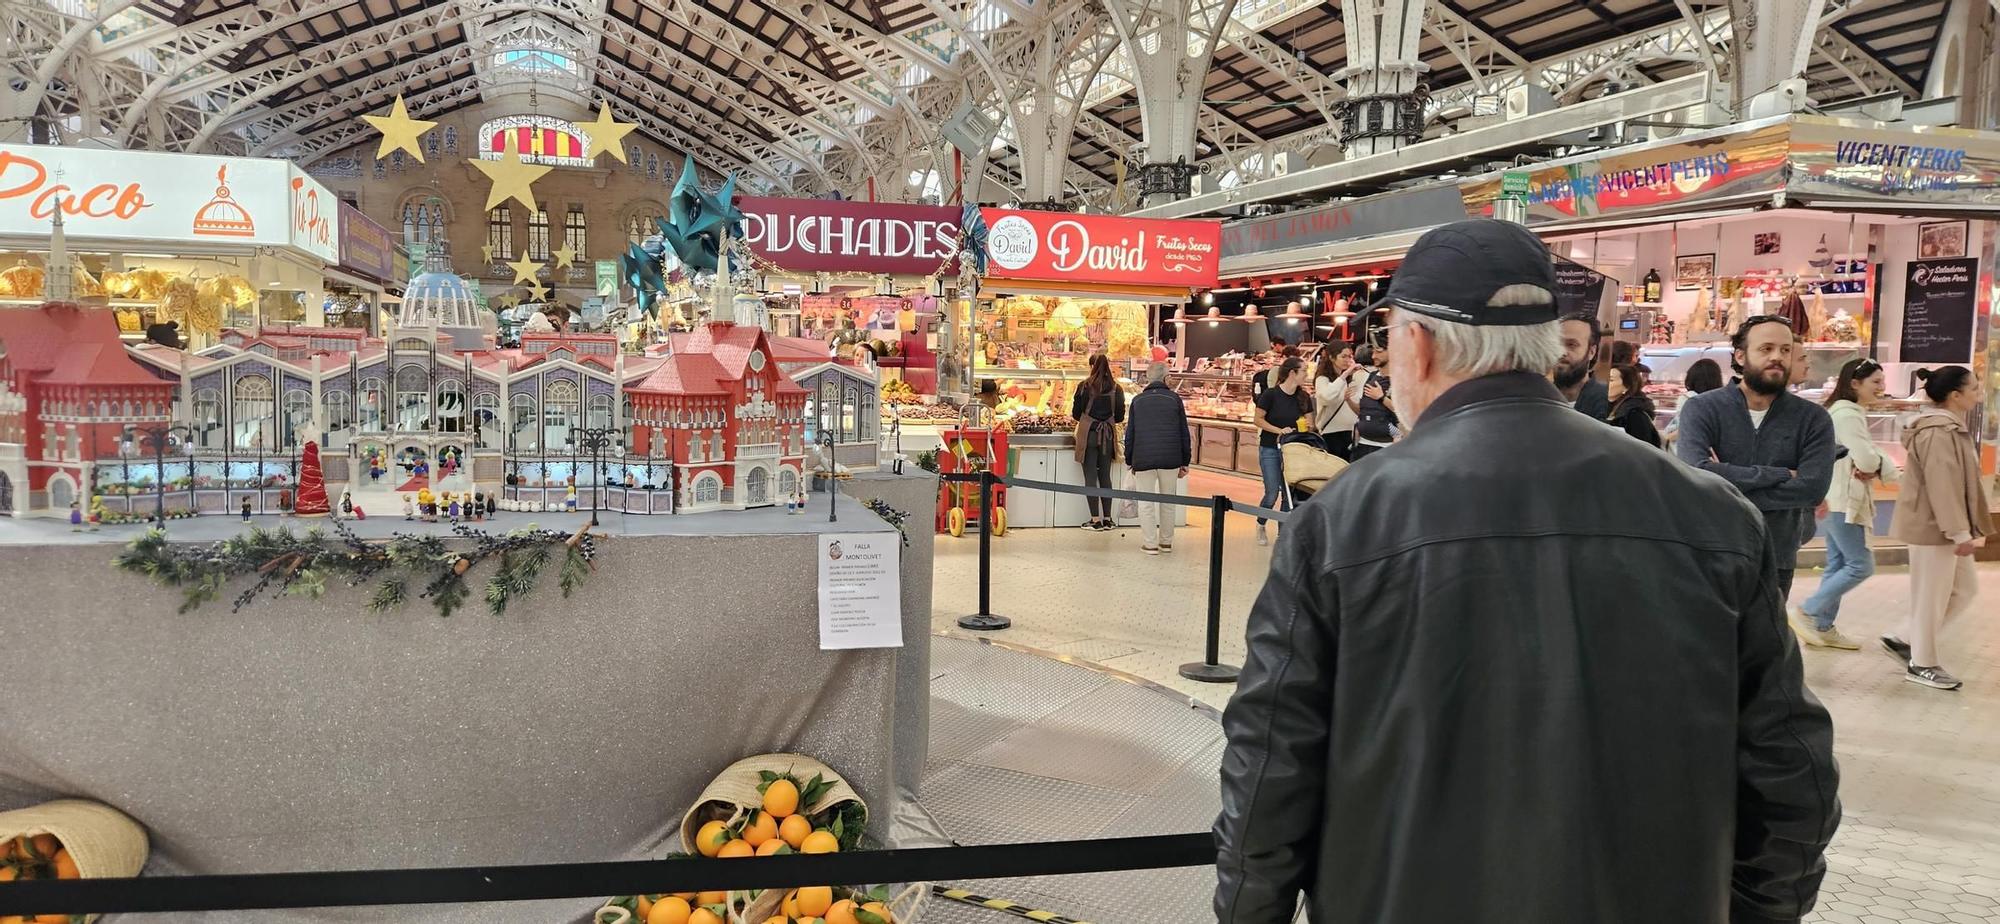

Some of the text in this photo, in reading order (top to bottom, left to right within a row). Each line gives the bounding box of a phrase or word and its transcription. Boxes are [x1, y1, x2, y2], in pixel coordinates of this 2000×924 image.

[0, 151, 154, 219] Paco
[740, 212, 959, 260] PUCHADES
[993, 234, 1032, 254] David
[1047, 220, 1147, 272] David
[1156, 235, 1187, 251] Frutos
[1188, 236, 1213, 252] Secos
